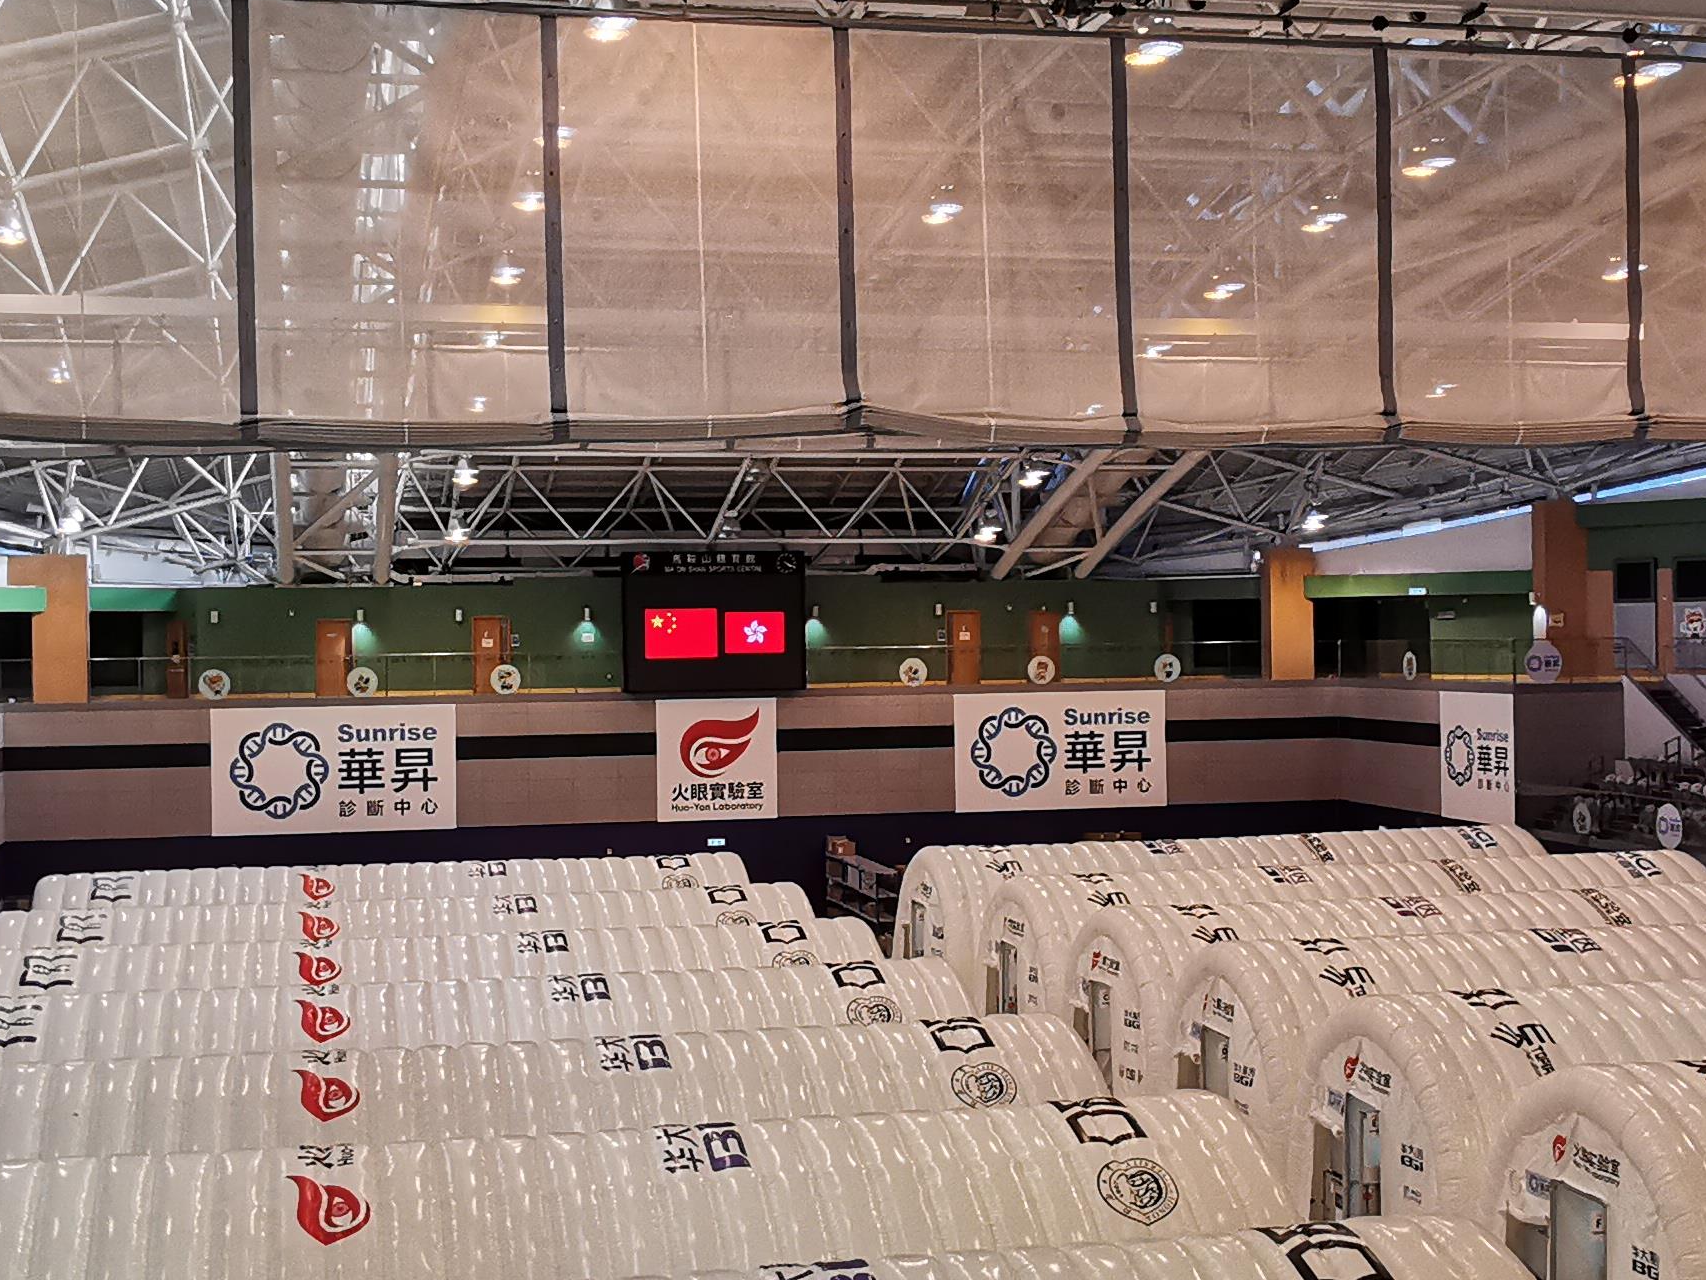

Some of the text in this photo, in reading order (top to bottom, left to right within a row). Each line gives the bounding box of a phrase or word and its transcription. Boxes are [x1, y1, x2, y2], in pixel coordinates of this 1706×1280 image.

[1064, 707, 1151, 725] Sunrise
[337, 723, 438, 743] Sunrise
[1064, 730, 1152, 774] 華昇
[338, 748, 438, 794] 華昇
[671, 782, 764, 802] 火眼實驗室
[1064, 777, 1152, 796] 診斷中心
[338, 798, 438, 818] 診斷中心
